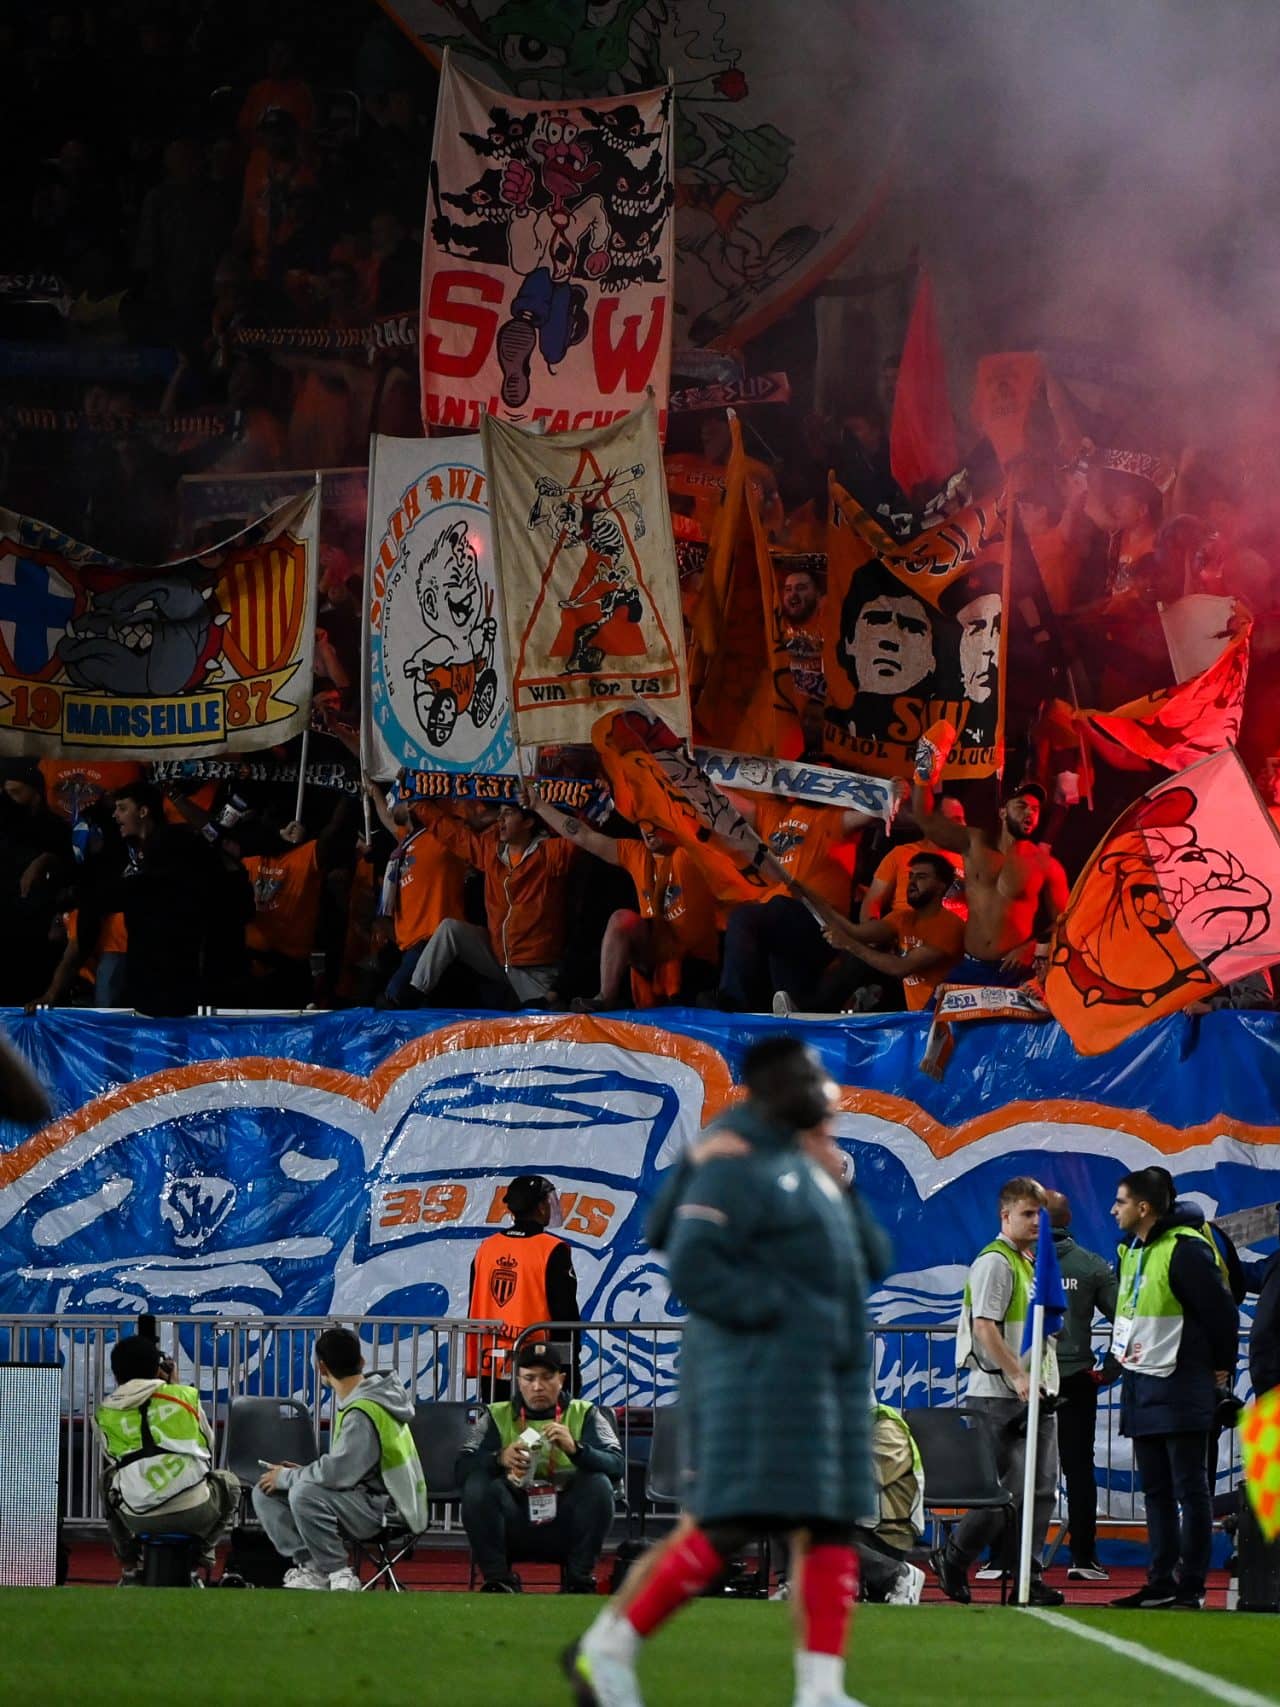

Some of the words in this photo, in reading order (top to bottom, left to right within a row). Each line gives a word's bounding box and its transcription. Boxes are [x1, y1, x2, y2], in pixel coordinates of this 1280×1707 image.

[424, 269, 503, 378] S
[591, 297, 667, 394] W
[426, 393, 499, 427] ANTI
[448, 467, 488, 506] WI
[589, 679, 620, 696] for
[11, 686, 61, 726] 19
[66, 700, 220, 738] MARSEILLE
[227, 679, 273, 725] 87
[379, 1184, 467, 1227] 39
